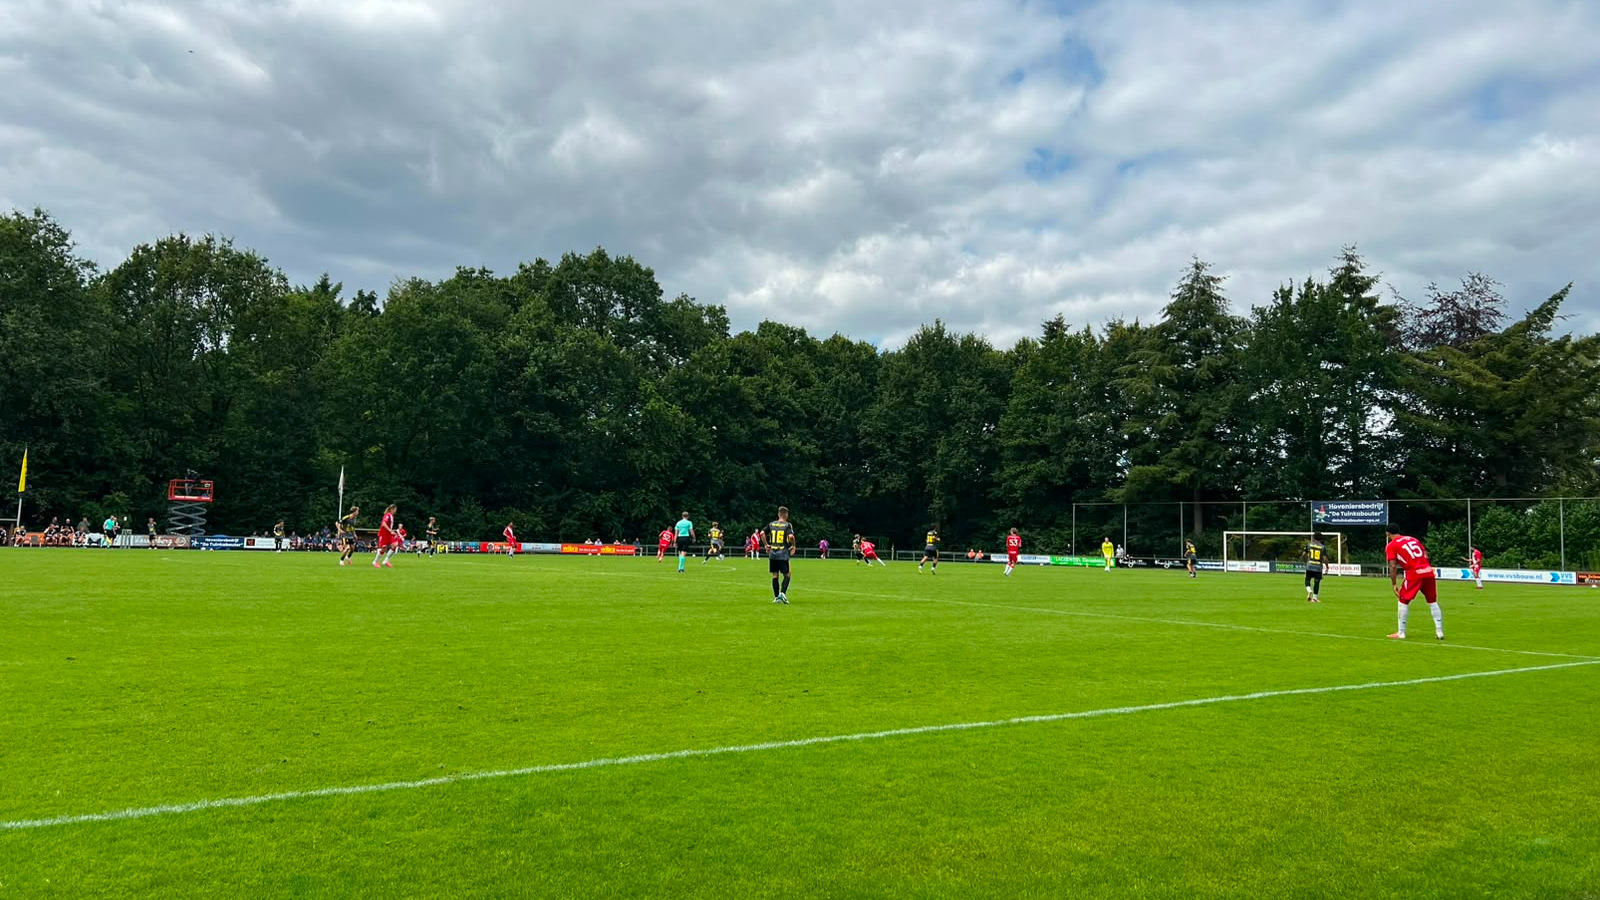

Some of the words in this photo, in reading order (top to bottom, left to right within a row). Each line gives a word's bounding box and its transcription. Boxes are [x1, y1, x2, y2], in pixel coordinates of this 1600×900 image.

[1328, 502, 1384, 510] Hoveniersbedrijf
[771, 530, 784, 543] 16
[1401, 541, 1423, 559] 15
